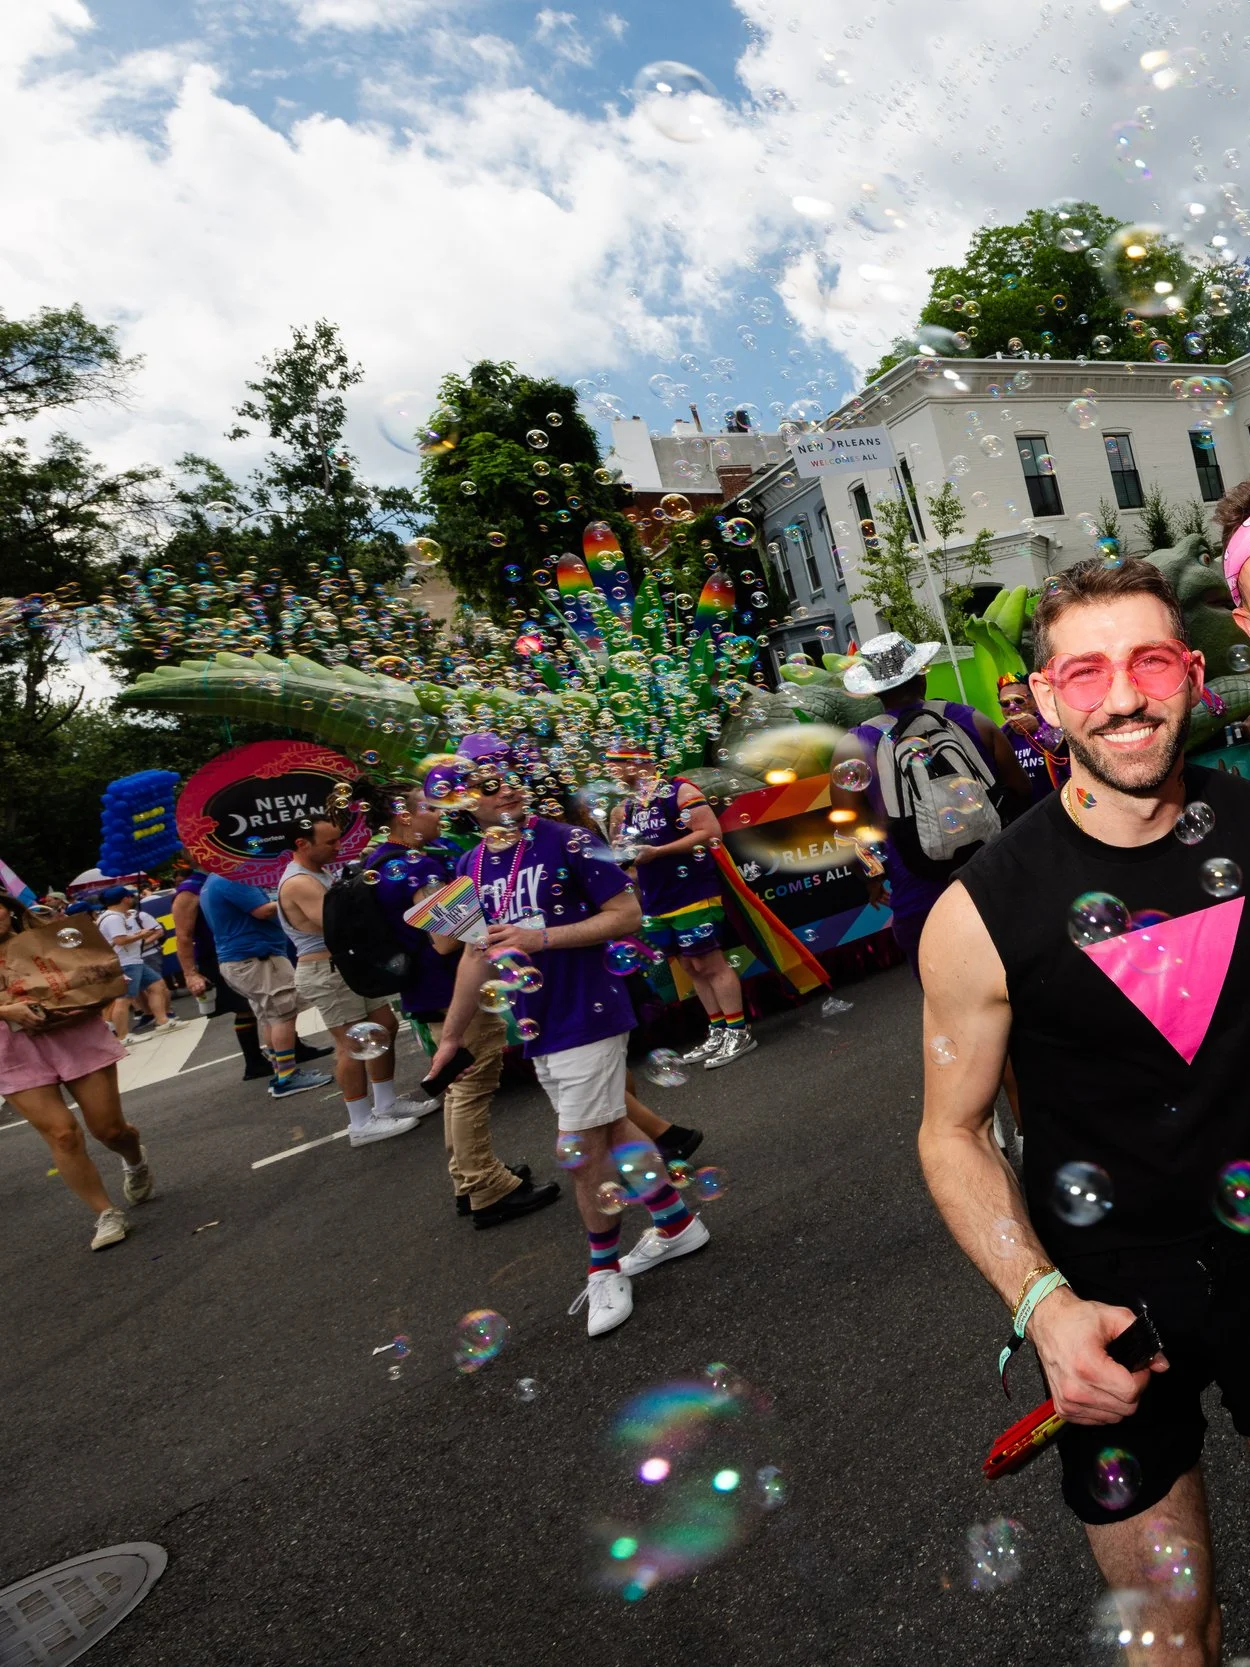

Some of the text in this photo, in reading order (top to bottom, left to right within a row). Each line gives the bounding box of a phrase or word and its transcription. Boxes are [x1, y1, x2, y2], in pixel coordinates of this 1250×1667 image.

[797, 442, 824, 455] NEW
[810, 453, 878, 467] WELCOMES ALL
[255, 793, 308, 812] NEW
[825, 865, 852, 882] ALL
[430, 904, 446, 919] WE
